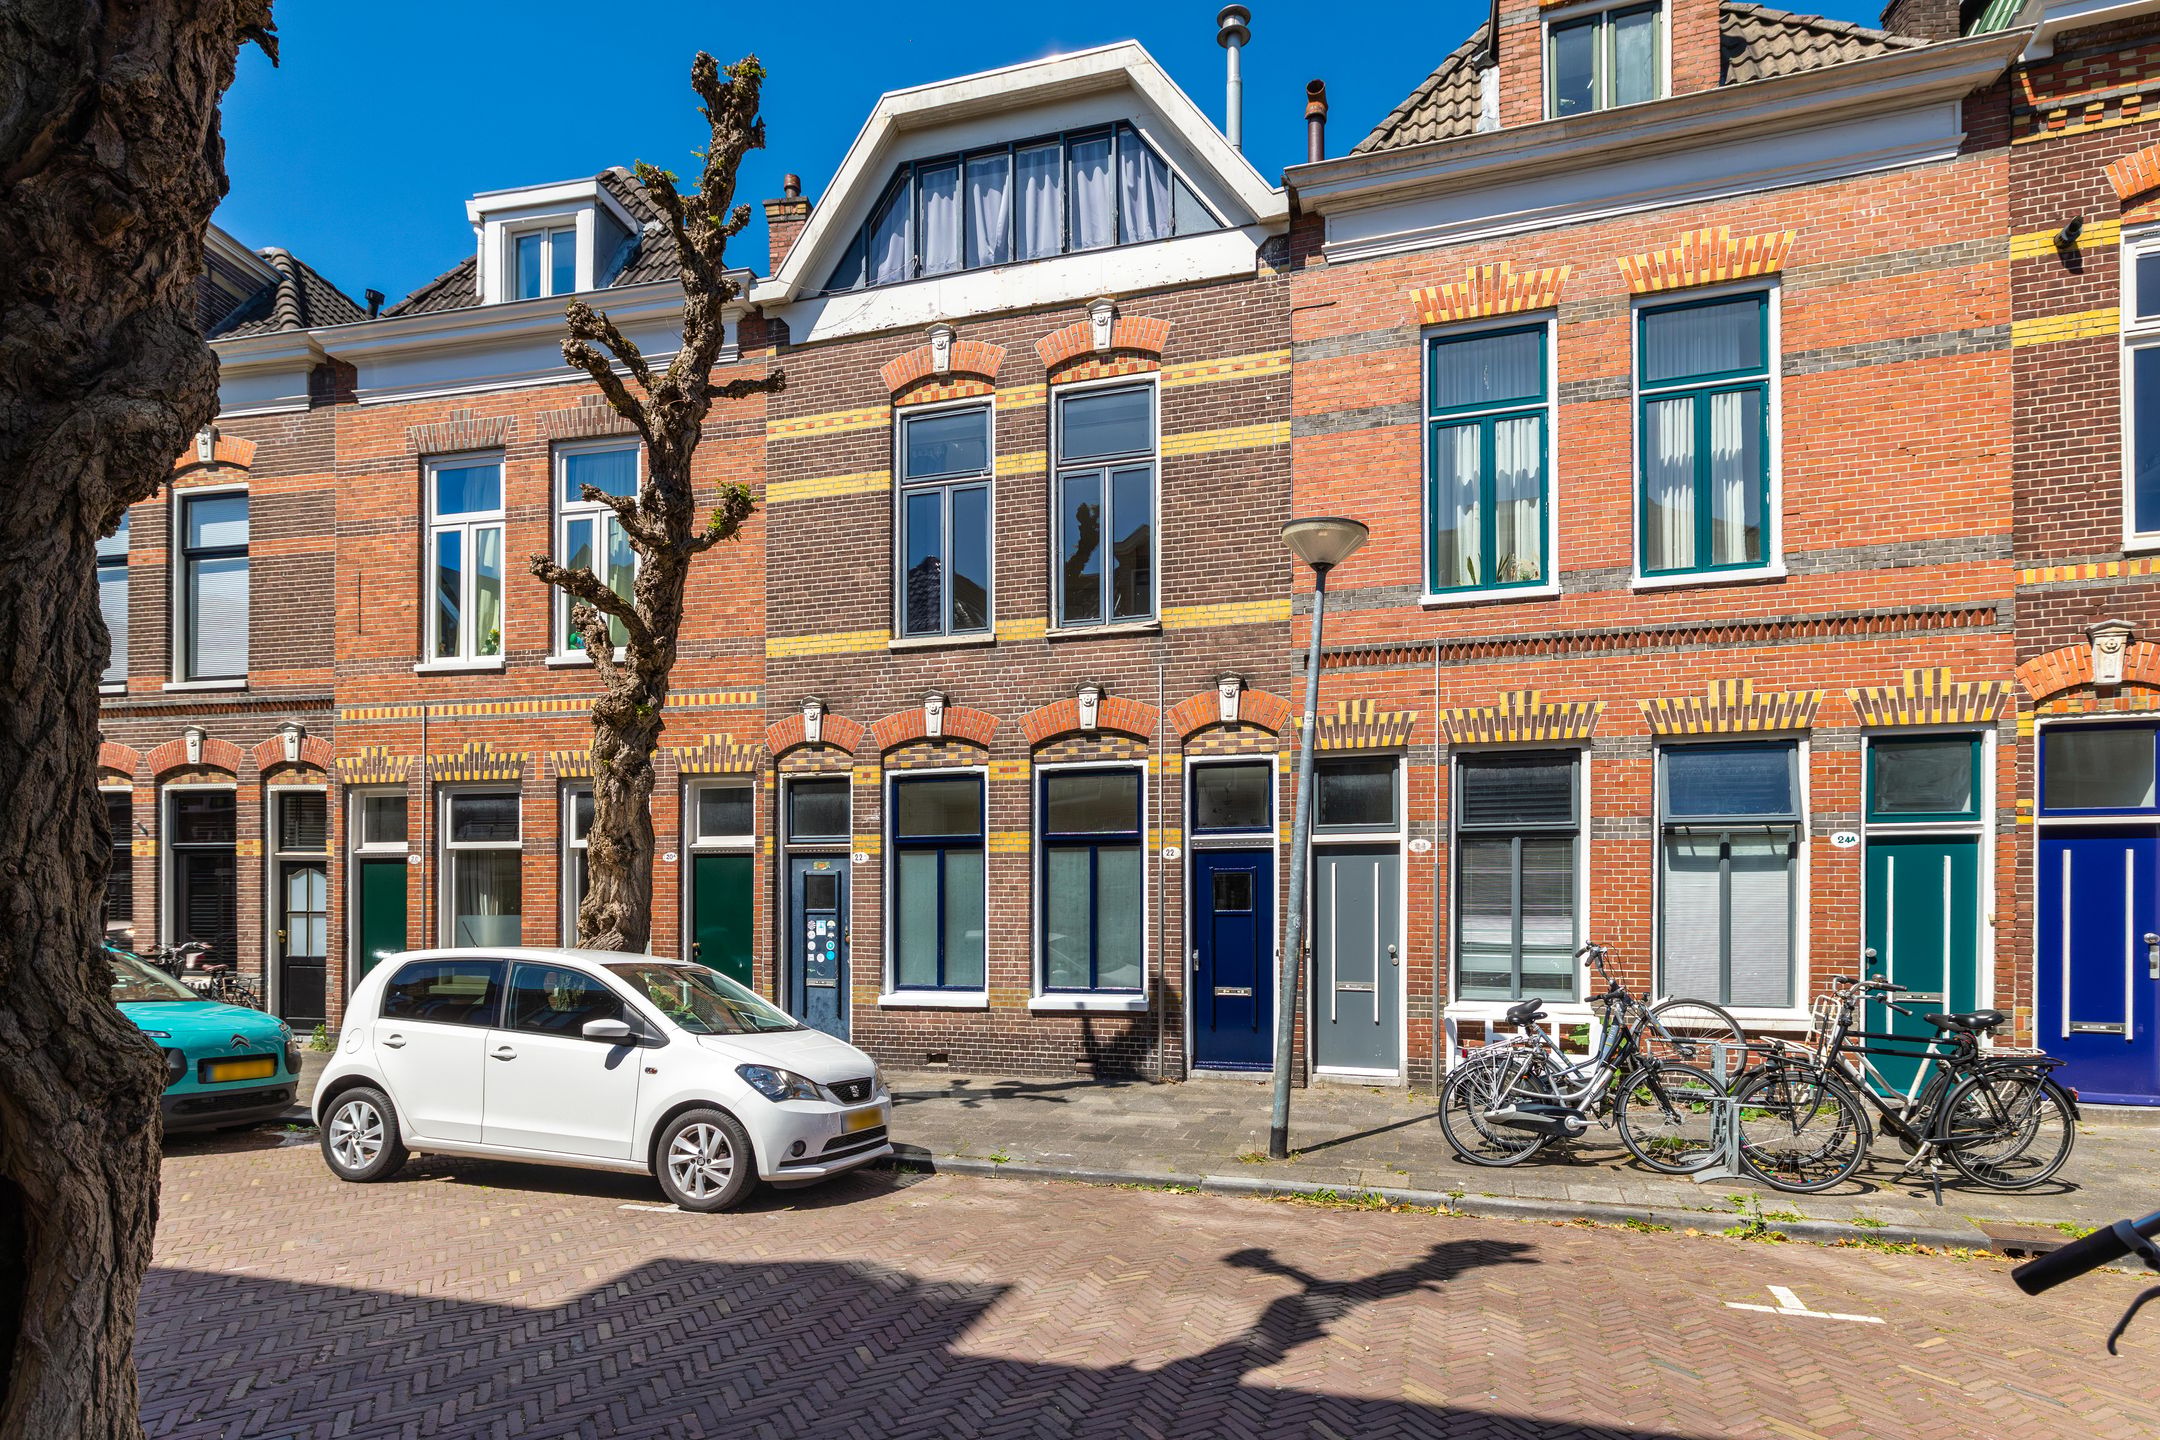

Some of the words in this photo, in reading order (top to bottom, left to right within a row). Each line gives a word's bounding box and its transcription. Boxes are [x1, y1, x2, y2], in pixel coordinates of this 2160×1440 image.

[1837, 835, 1856, 843] 24A
[1165, 848, 1175, 856] 22
[854, 853, 863, 861] 22
